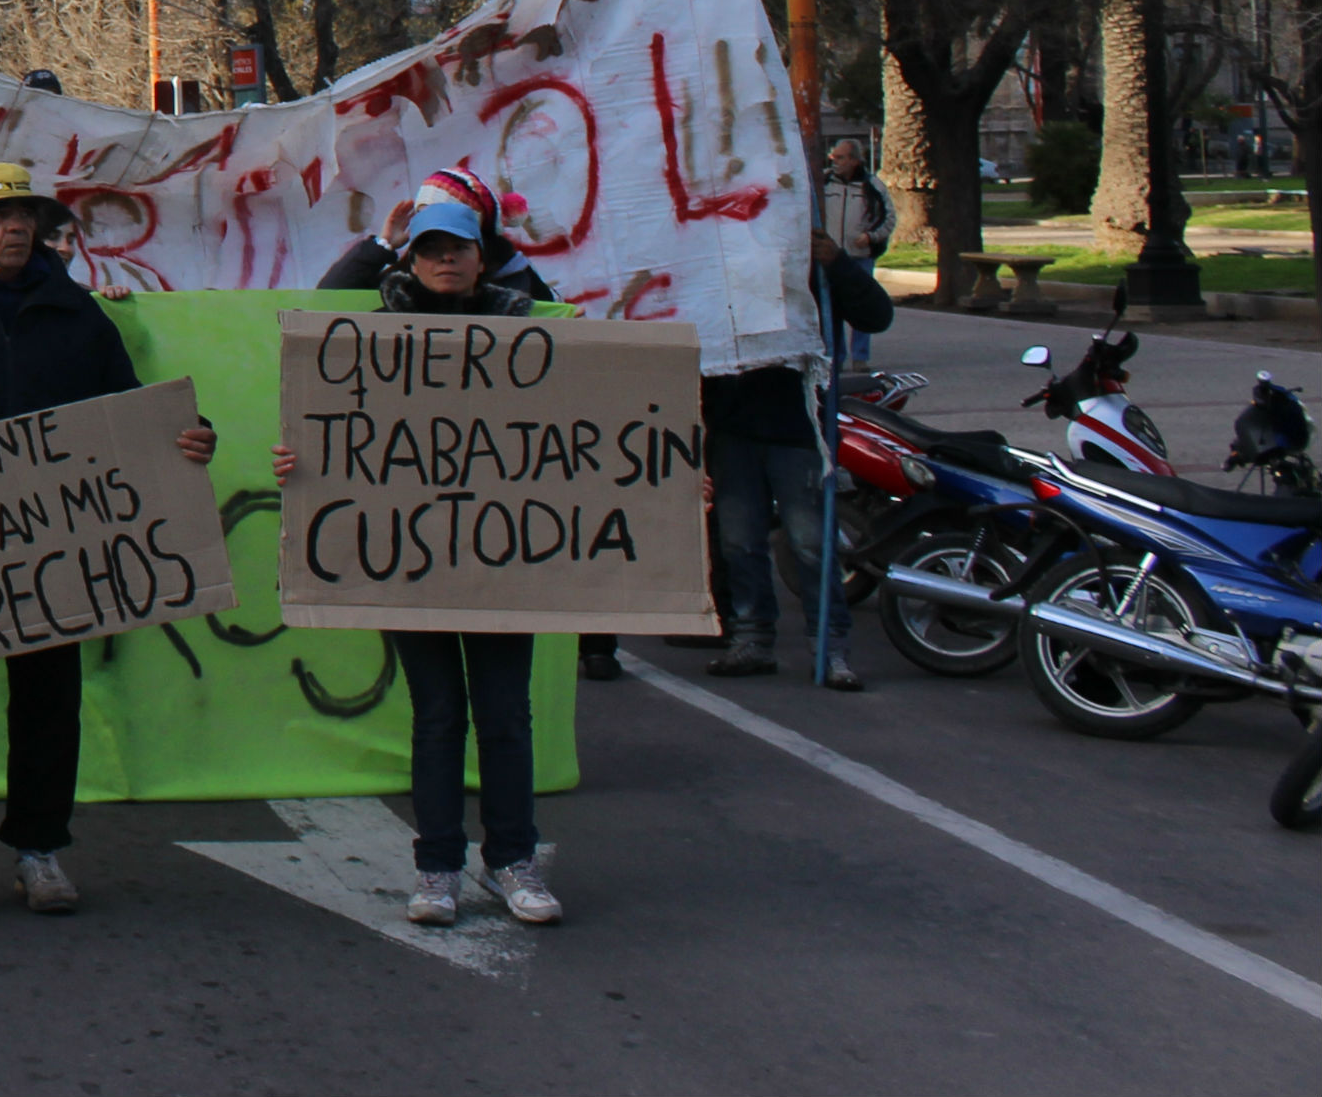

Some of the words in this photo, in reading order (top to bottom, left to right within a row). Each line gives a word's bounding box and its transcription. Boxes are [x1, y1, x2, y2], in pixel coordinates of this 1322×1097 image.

[317, 317, 554, 409] QUIERO
[304, 410, 601, 488] TRABAJAR
[614, 403, 703, 487] SIN
[59, 458, 142, 533] MIS
[306, 492, 638, 584] CUSTODIA
